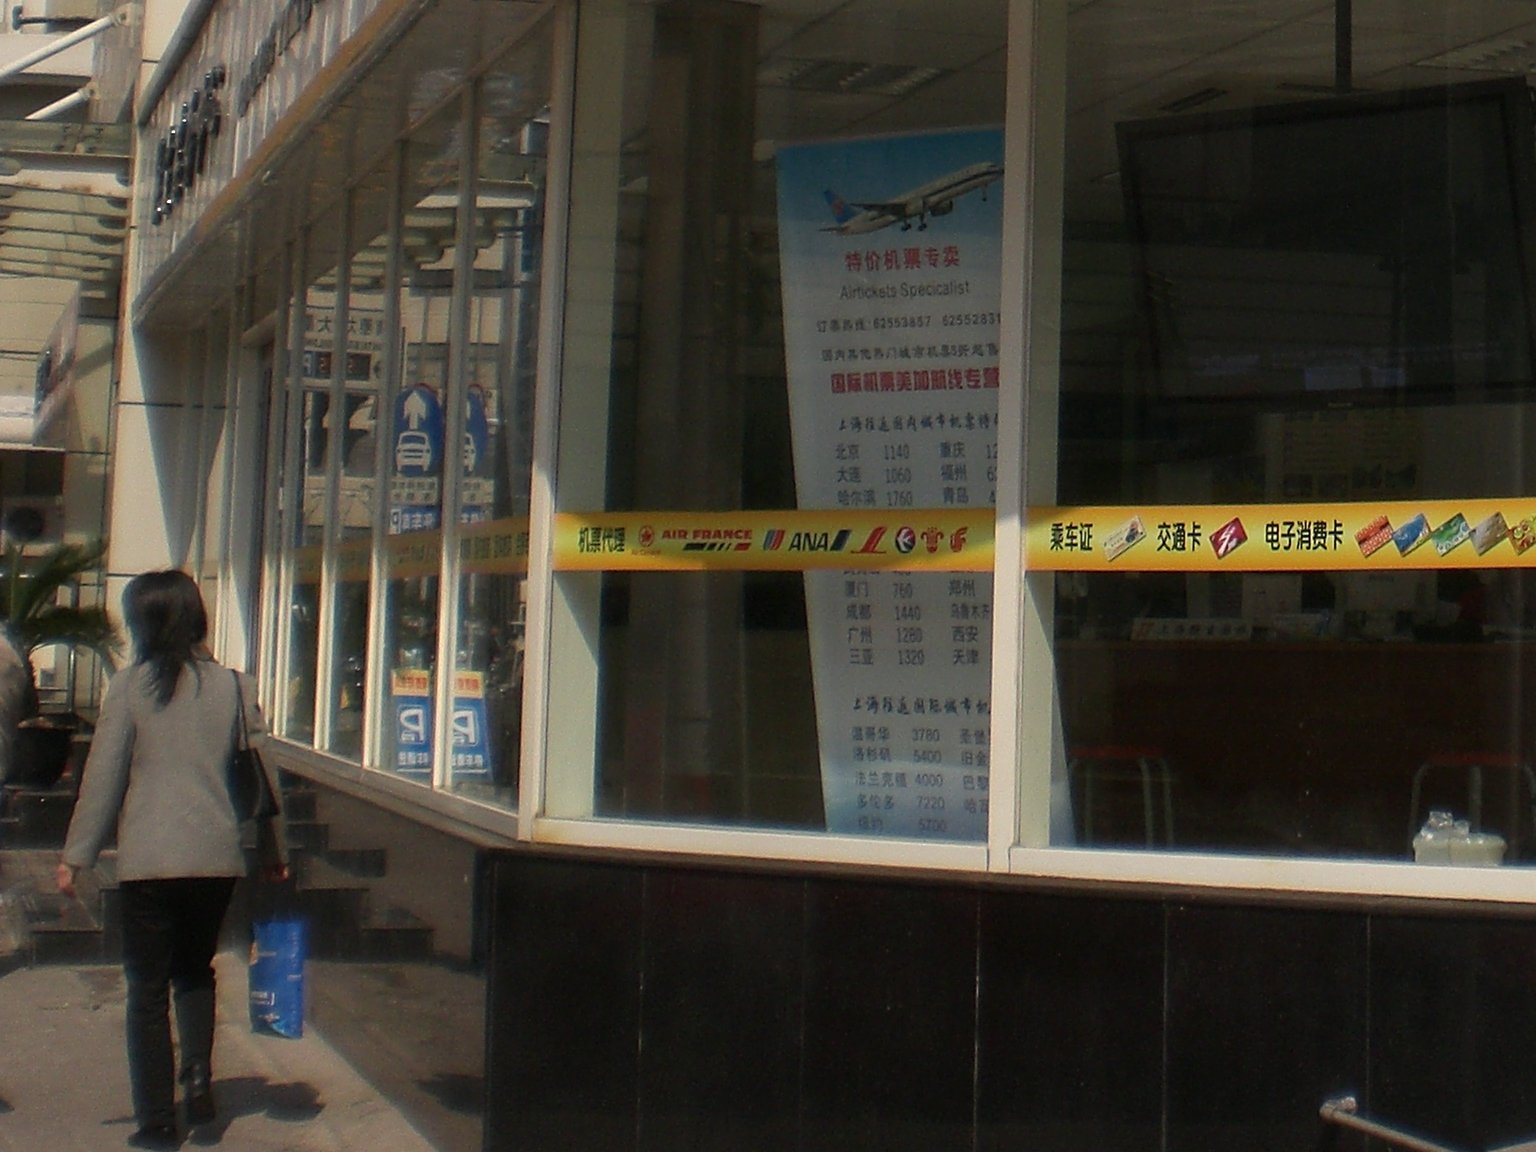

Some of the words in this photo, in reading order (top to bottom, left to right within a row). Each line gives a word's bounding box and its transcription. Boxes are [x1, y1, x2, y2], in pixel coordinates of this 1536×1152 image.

[845, 246, 961, 272] 特价机票专卖
[840, 282, 897, 300] Airtickets
[835, 443, 860, 460] 北京
[884, 444, 910, 460] 1140
[837, 466, 861, 483] 大连
[837, 489, 876, 506] 哈尔滨
[578, 526, 625, 553] 机票代理
[662, 529, 688, 540] AIR
[692, 529, 753, 540] FRANCE
[789, 532, 829, 552] ANA
[1050, 522, 1093, 552] 乘车证
[1157, 521, 1202, 551] 交通卡
[1265, 520, 1344, 551] 电子消费卡
[848, 626, 873, 644] 广州
[850, 648, 874, 665] 三亚
